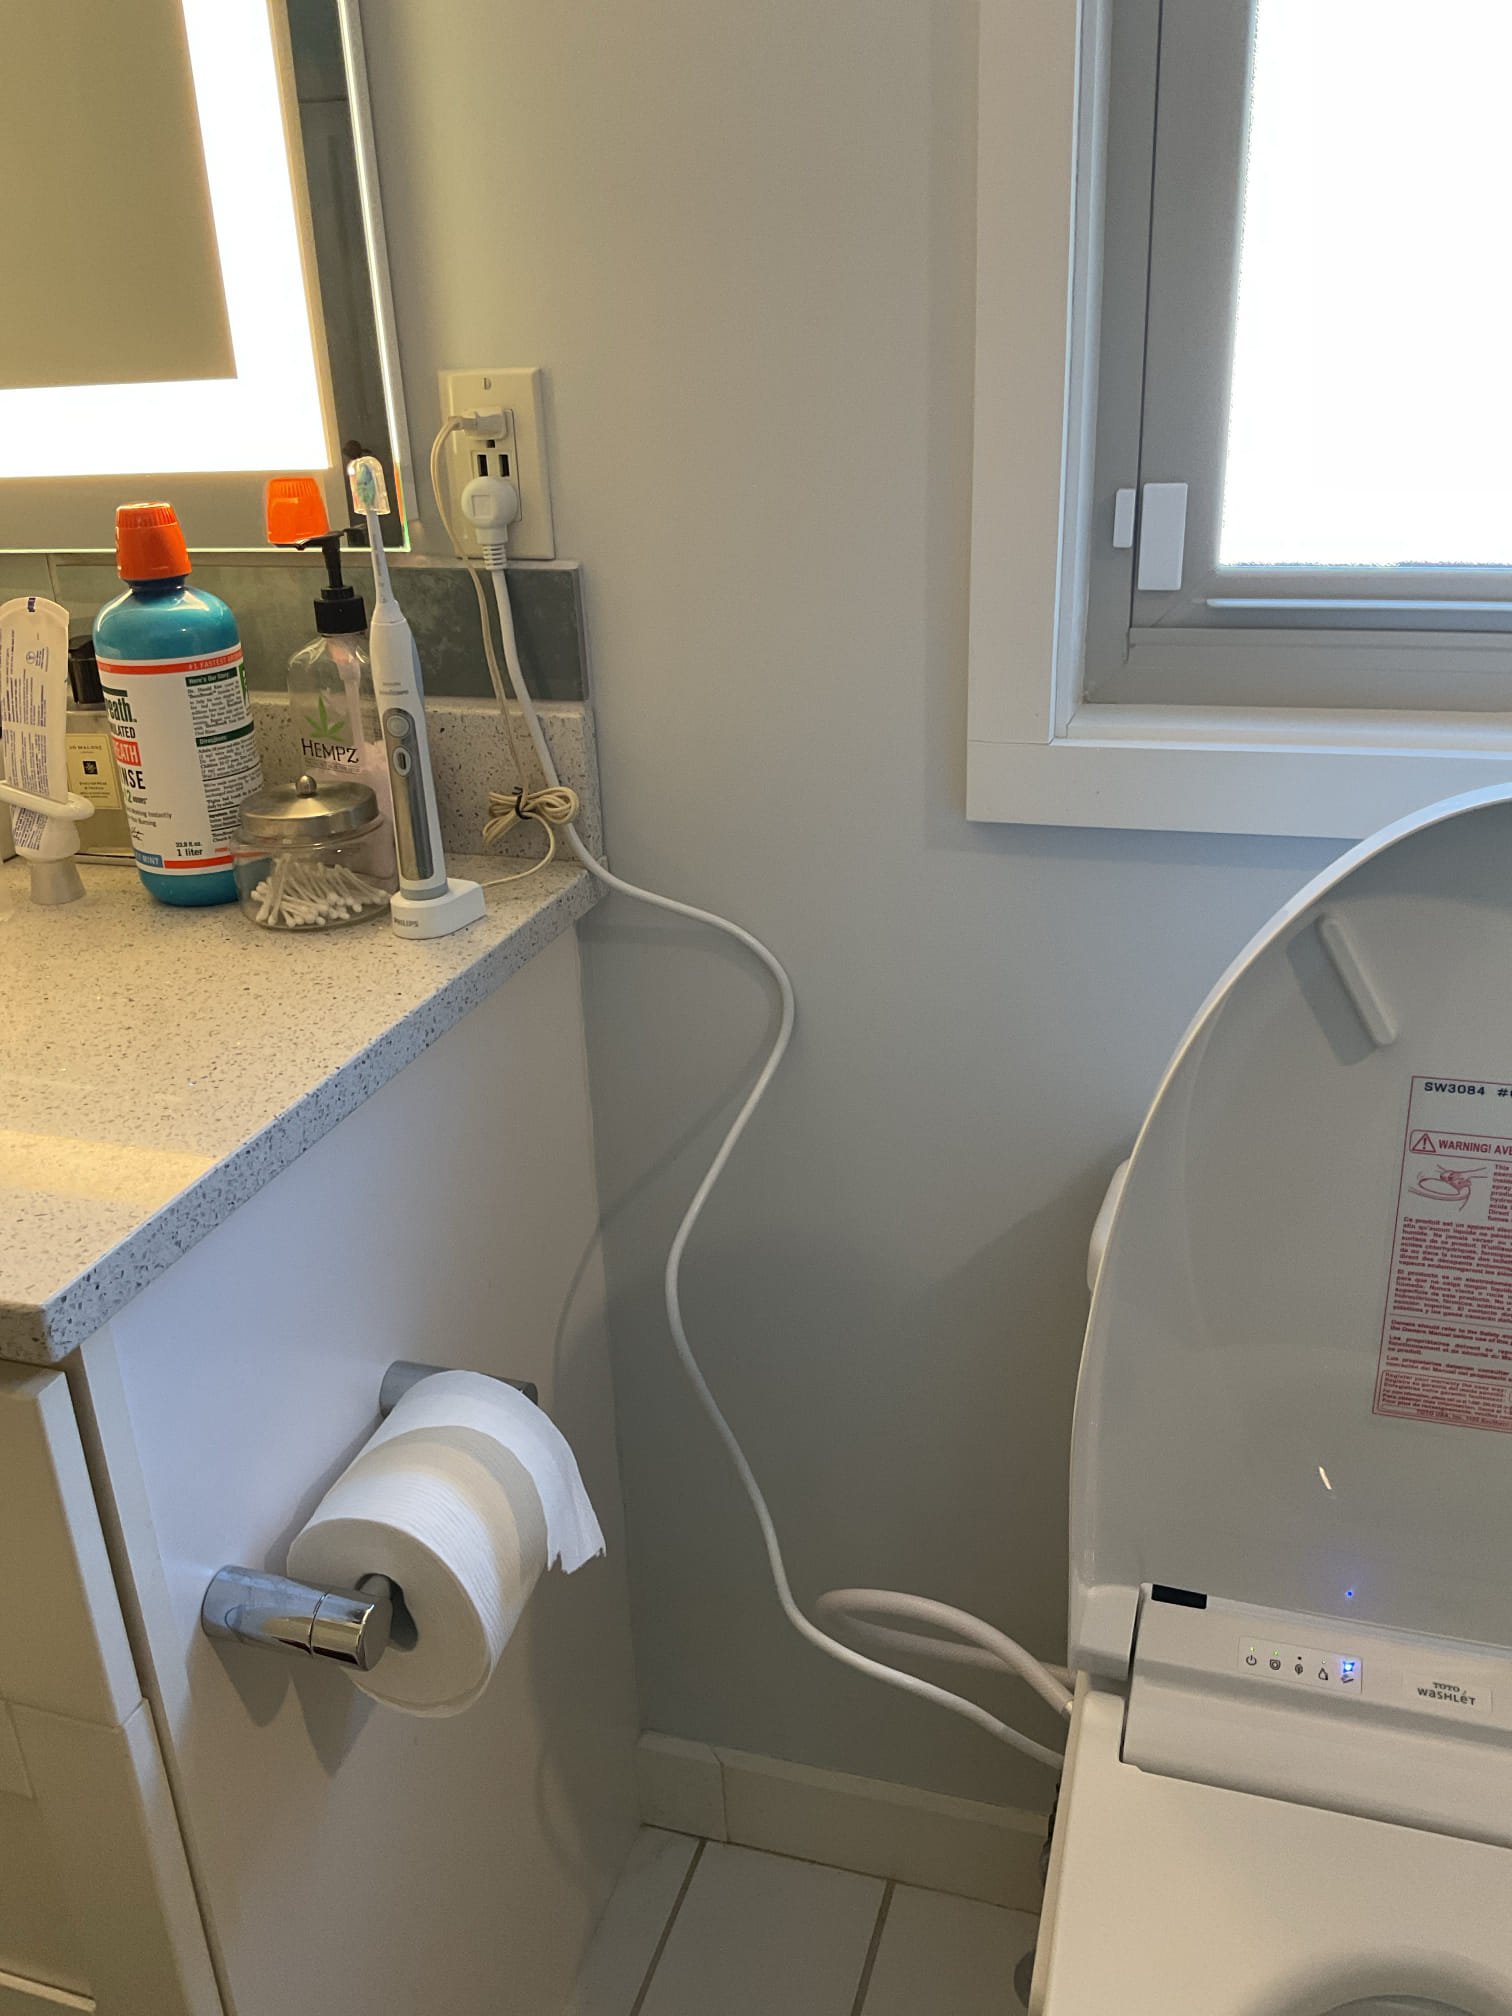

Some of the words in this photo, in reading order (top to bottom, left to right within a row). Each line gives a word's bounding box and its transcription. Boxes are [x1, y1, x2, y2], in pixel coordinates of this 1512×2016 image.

[301, 738, 359, 763] HEMPZ
[185, 848, 204, 856] liter
[1424, 1081, 1486, 1096] SW3084
[1438, 1139, 1492, 1154] WARNING!
[1432, 1681, 1461, 1692] TOTO
